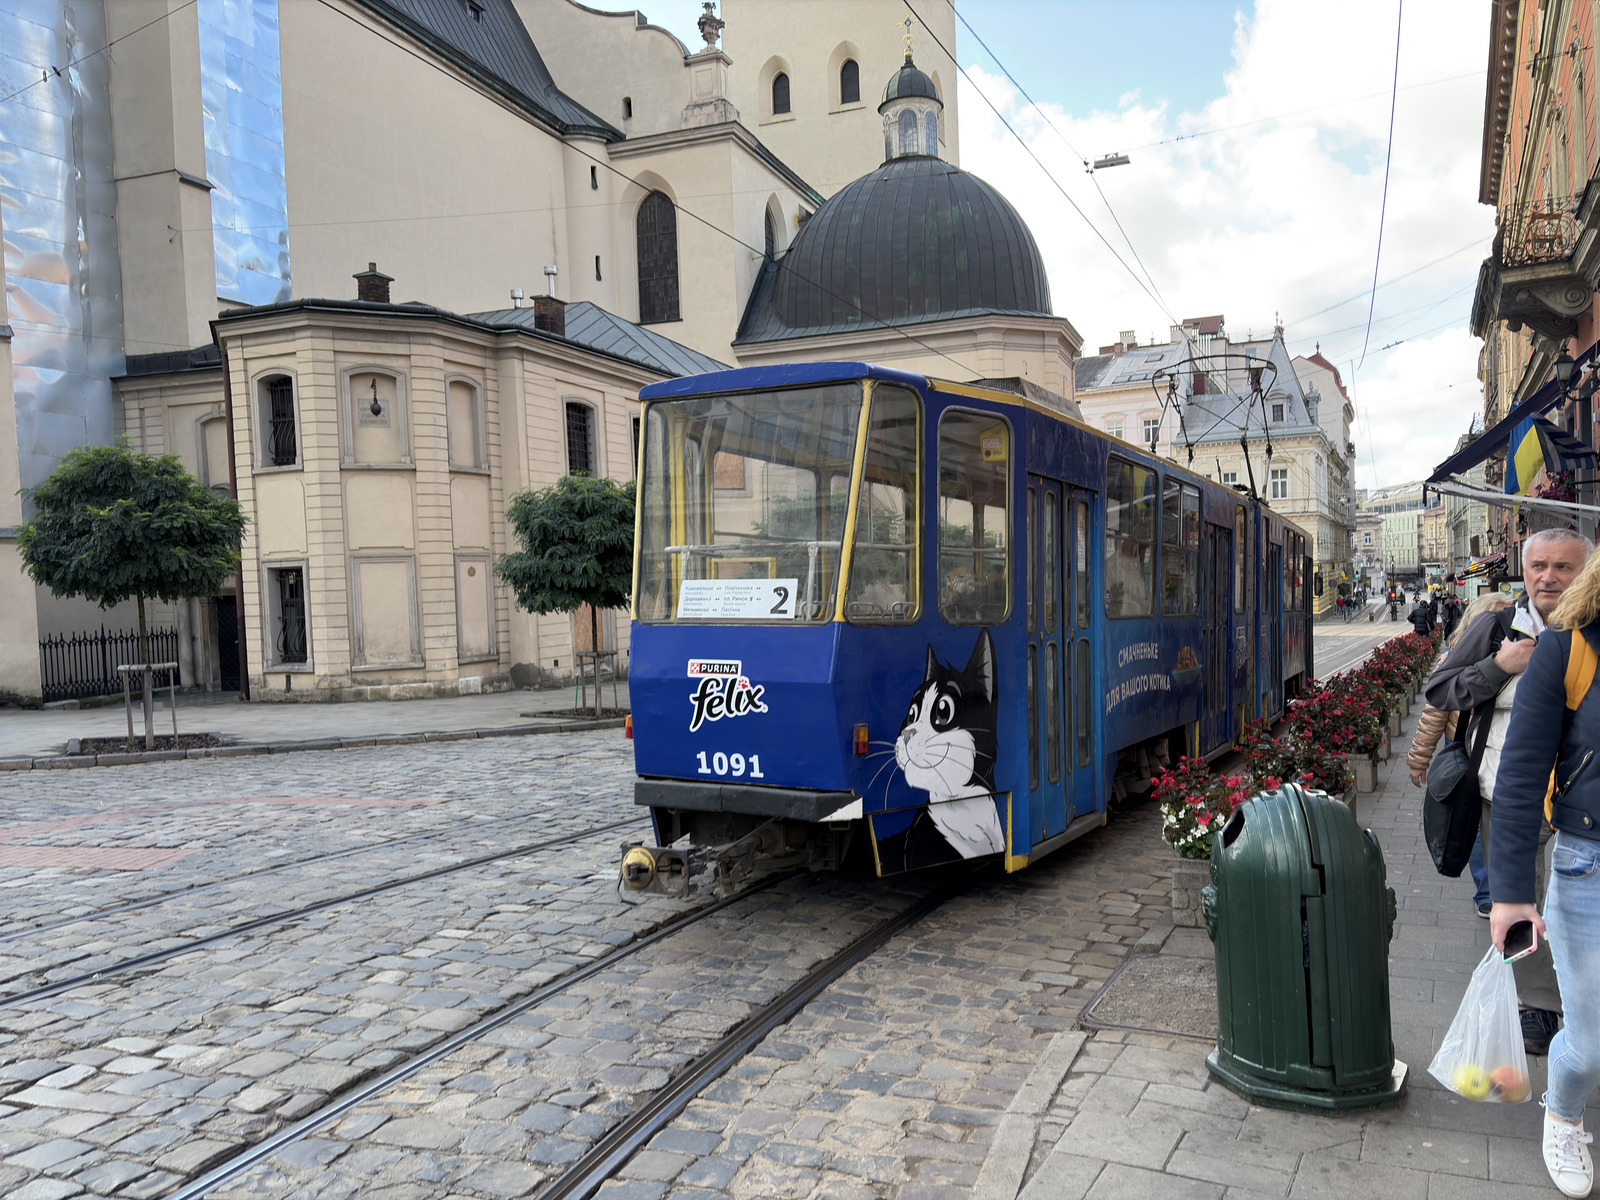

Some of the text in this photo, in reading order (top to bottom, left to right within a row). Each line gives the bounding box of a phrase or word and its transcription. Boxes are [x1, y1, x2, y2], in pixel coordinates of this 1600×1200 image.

[769, 586, 790, 615] 2
[701, 664, 737, 674] PURINA
[1118, 642, 1159, 668] СМАЧНЕНЬКЕ
[691, 677, 763, 731] felix
[1105, 674, 1171, 716] ДЛЯ ВАШОГО КОТИКА
[696, 750, 765, 779] 1091
